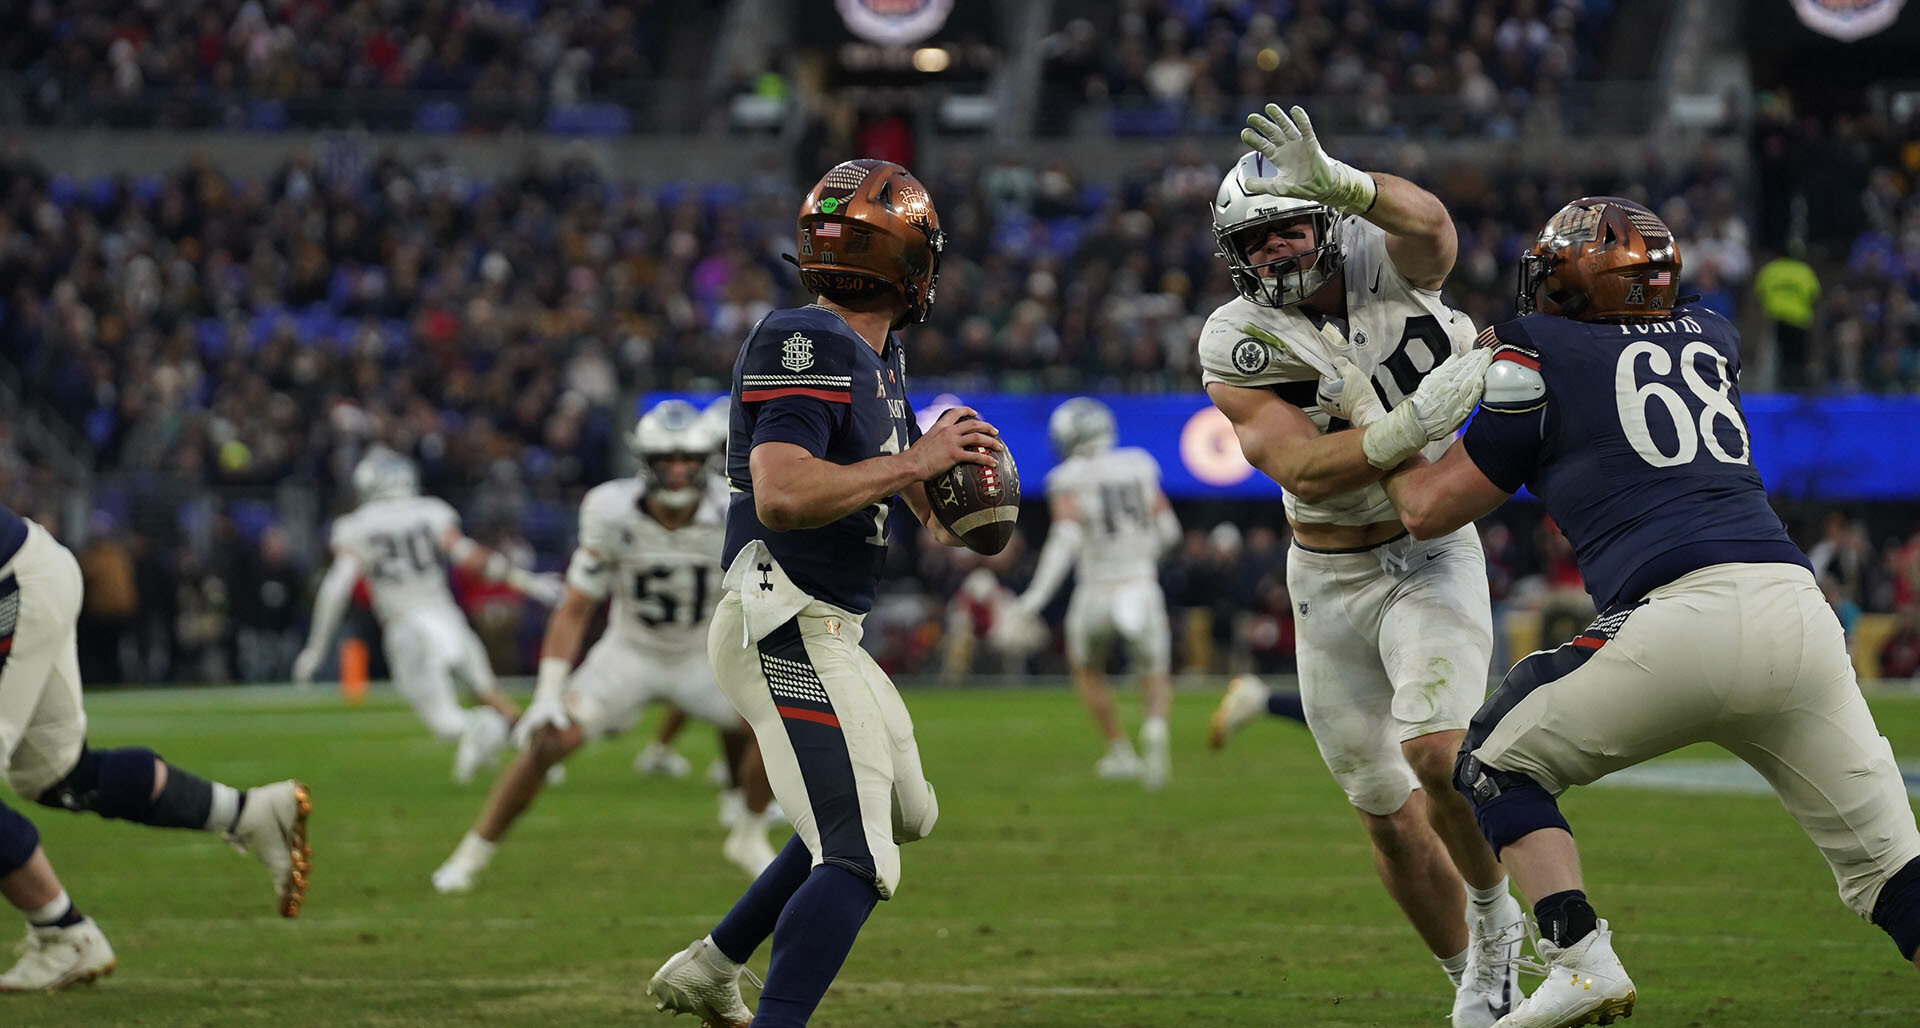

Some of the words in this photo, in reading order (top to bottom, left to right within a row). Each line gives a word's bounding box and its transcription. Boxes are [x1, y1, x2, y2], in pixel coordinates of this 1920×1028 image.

[821, 252, 837, 266] 11
[835, 275, 864, 289] 250
[1615, 341, 1749, 468] 68
[633, 565, 706, 628] 51
